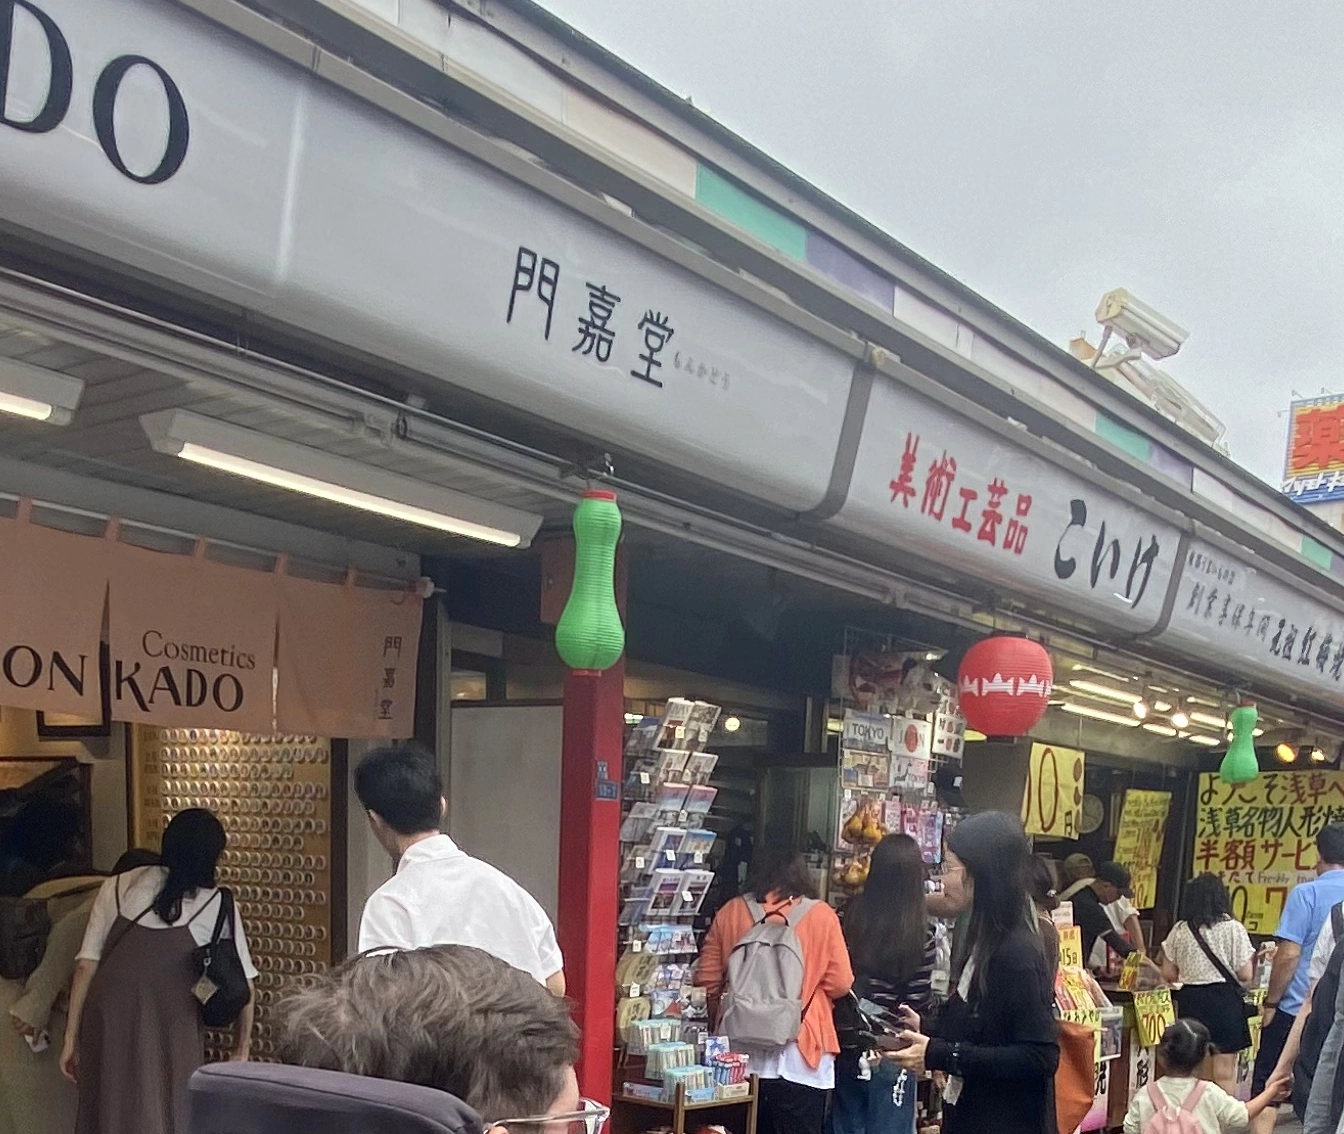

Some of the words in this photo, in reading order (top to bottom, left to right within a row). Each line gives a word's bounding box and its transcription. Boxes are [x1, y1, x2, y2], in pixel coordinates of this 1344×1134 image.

[507, 246, 674, 389] 門嘉堂
[889, 433, 1034, 556] 美術工芸品
[1053, 499, 1161, 609] こいけ
[142, 630, 256, 671] Cosmetics
[114, 660, 244, 713] KADO
[851, 723, 885, 740] TOKYO
[1196, 839, 1320, 871] 半額サービ
